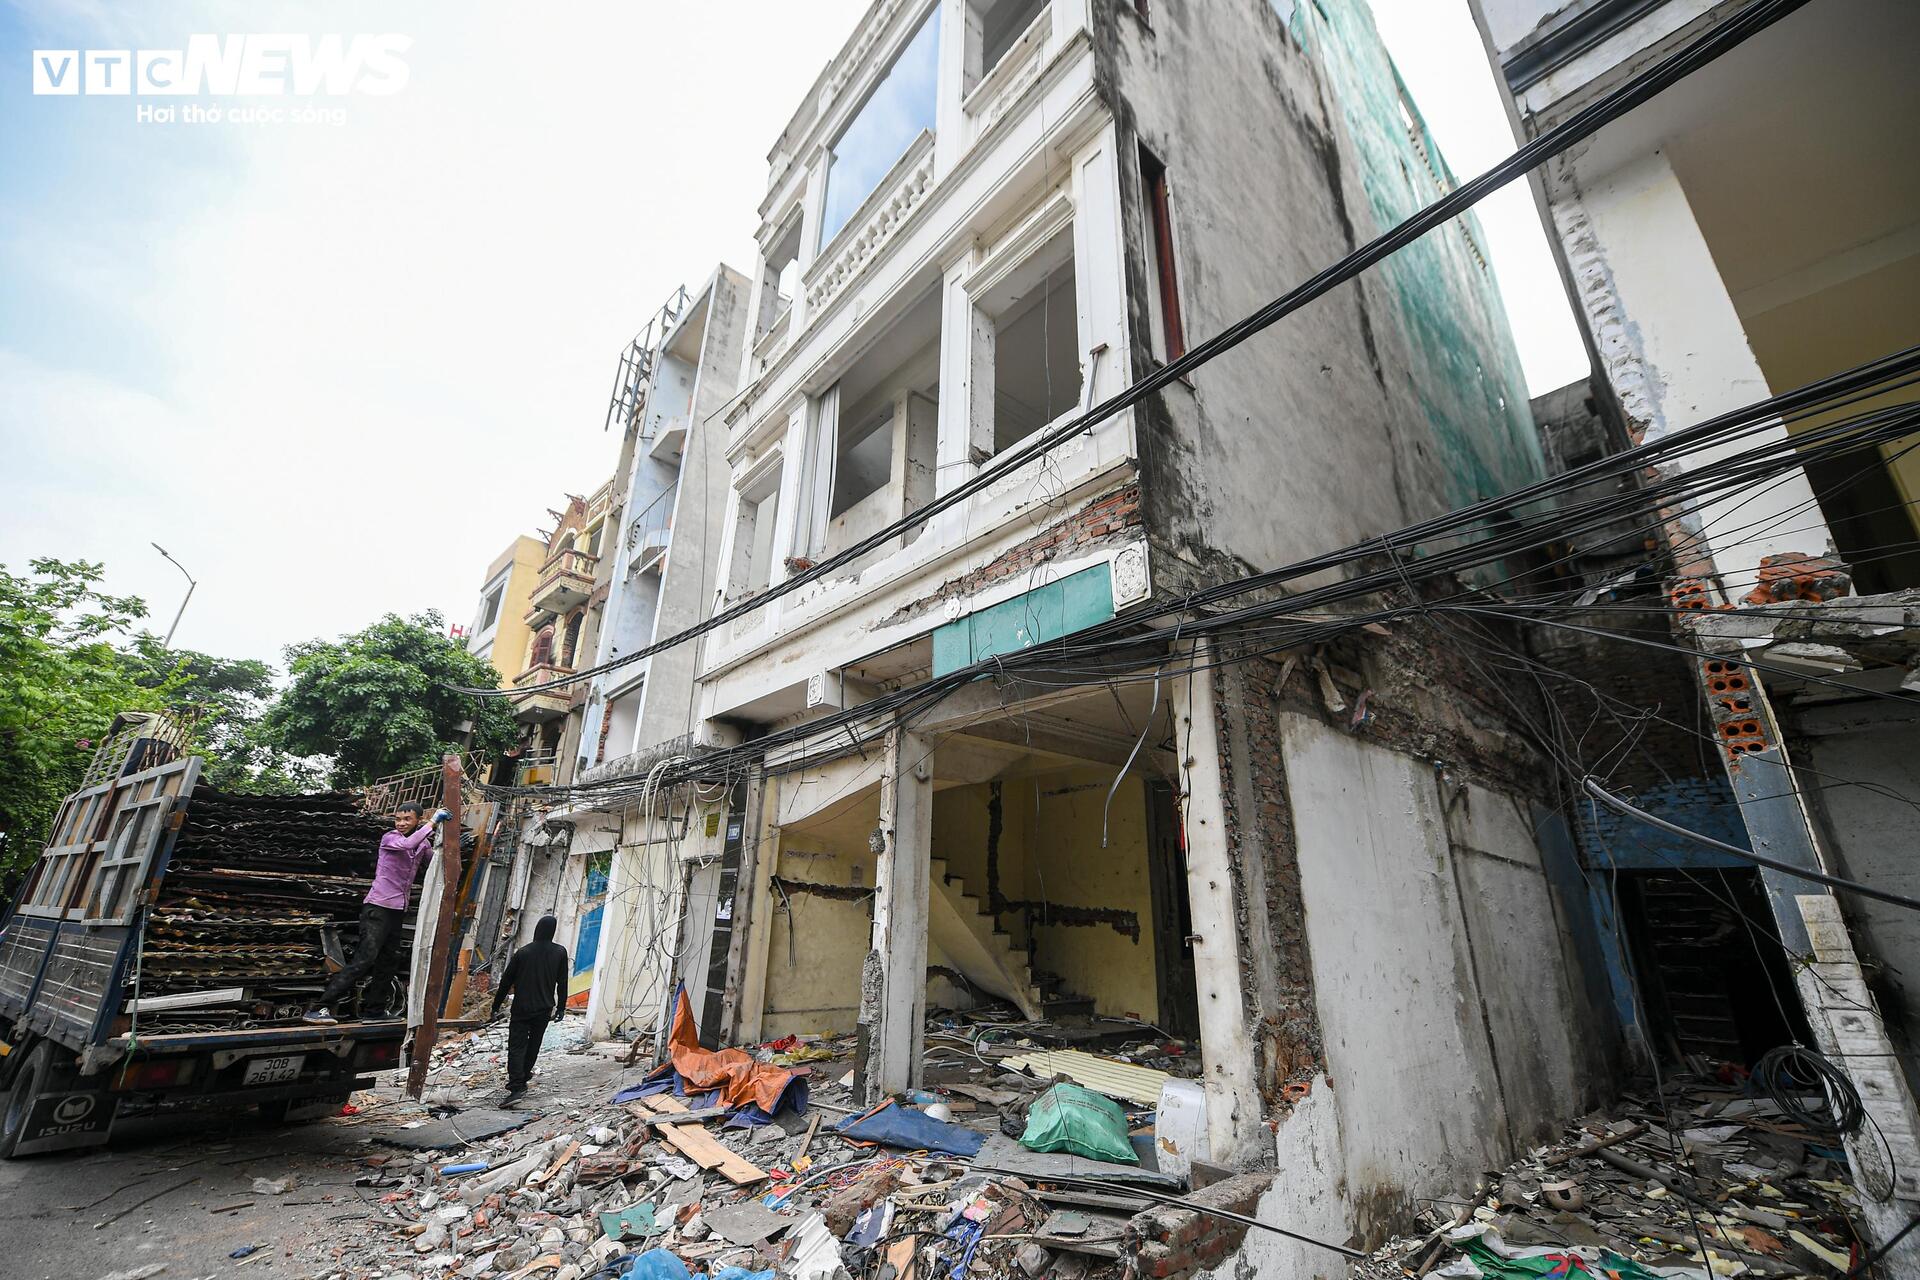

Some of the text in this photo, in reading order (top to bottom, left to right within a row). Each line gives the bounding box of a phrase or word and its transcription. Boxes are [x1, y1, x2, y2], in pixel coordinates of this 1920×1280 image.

[264, 1058, 289, 1070] 30B
[249, 1068, 295, 1085] 261.42
[38, 1121, 97, 1137] ISUZU
